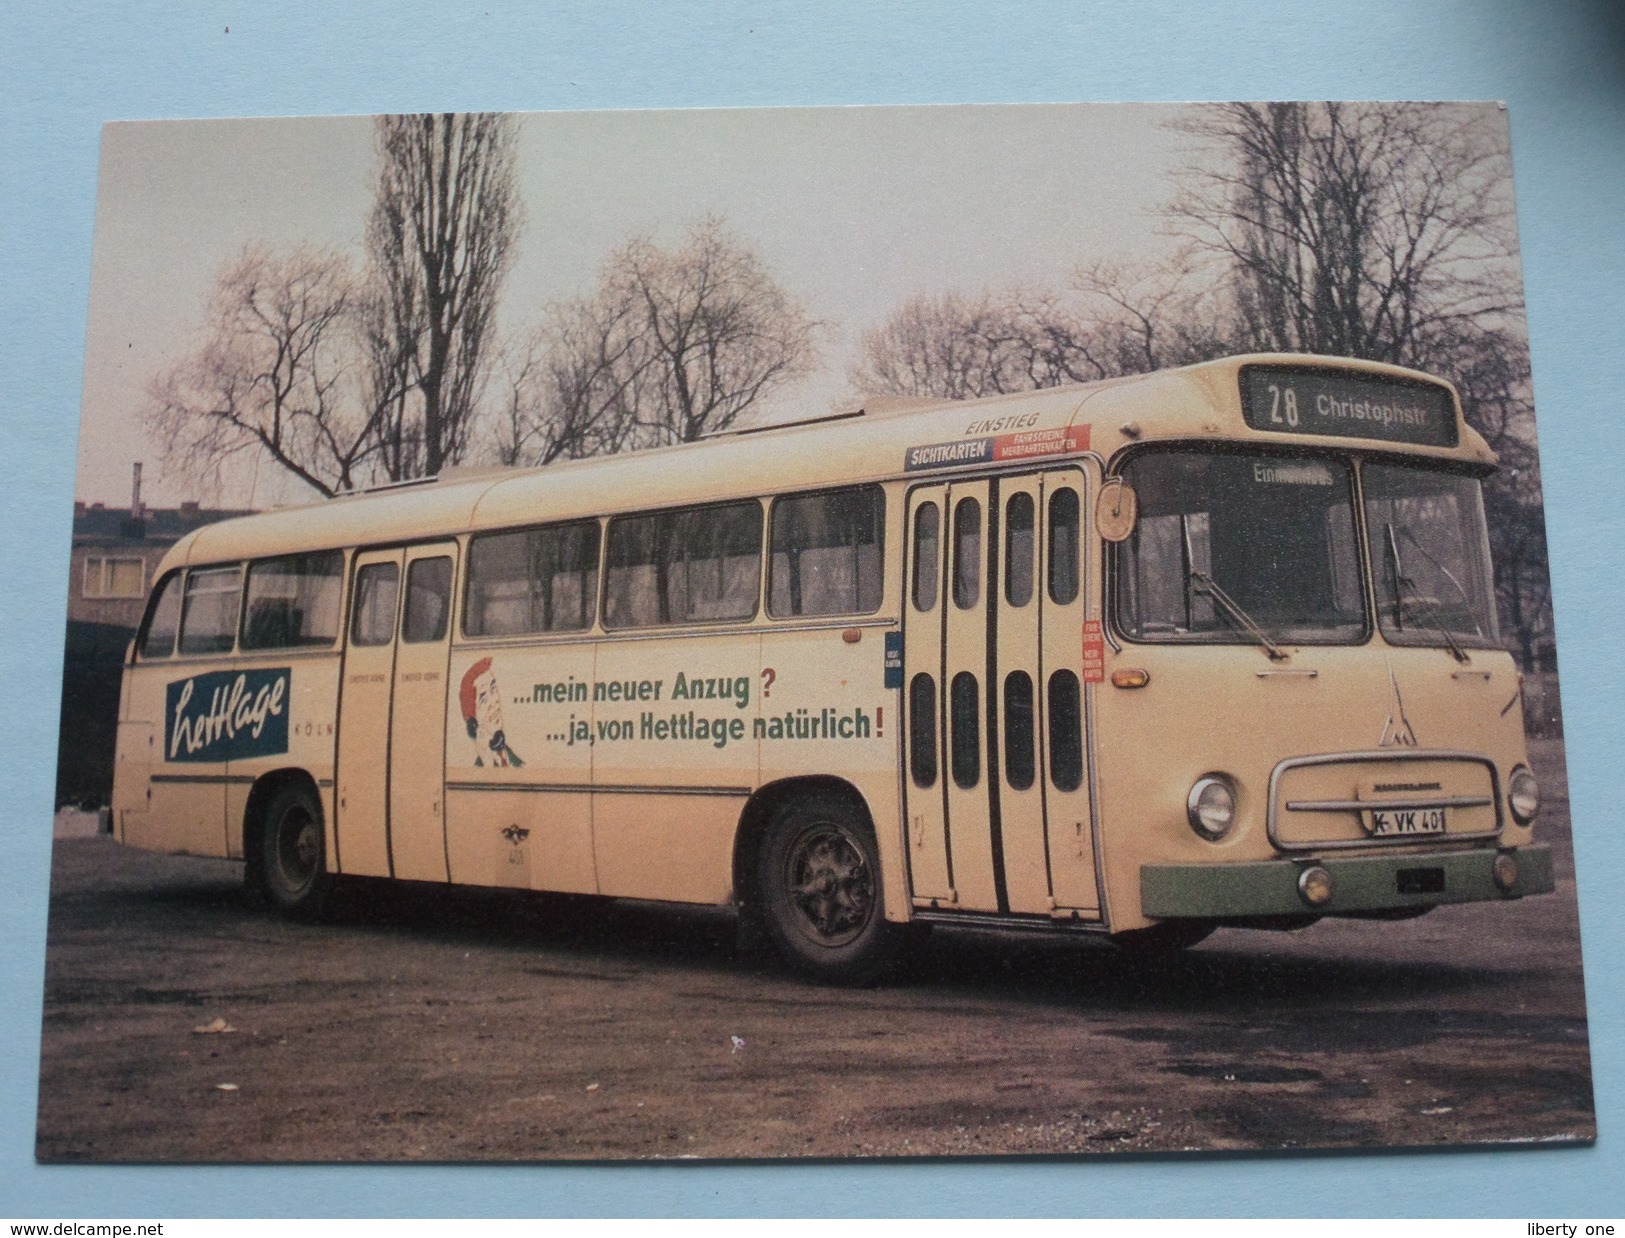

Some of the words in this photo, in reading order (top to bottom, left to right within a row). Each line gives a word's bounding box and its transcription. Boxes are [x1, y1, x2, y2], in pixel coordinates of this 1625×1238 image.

[1268, 384, 1298, 427] 28
[965, 412, 1040, 435] EINSTIEG
[911, 440, 986, 465] SICHTKARTEN
[593, 679, 663, 702] neuer
[671, 671, 749, 709] Anzug
[640, 711, 745, 749] Hettlage
[1394, 811, 1416, 832] VK
[1422, 811, 1446, 831] 401
